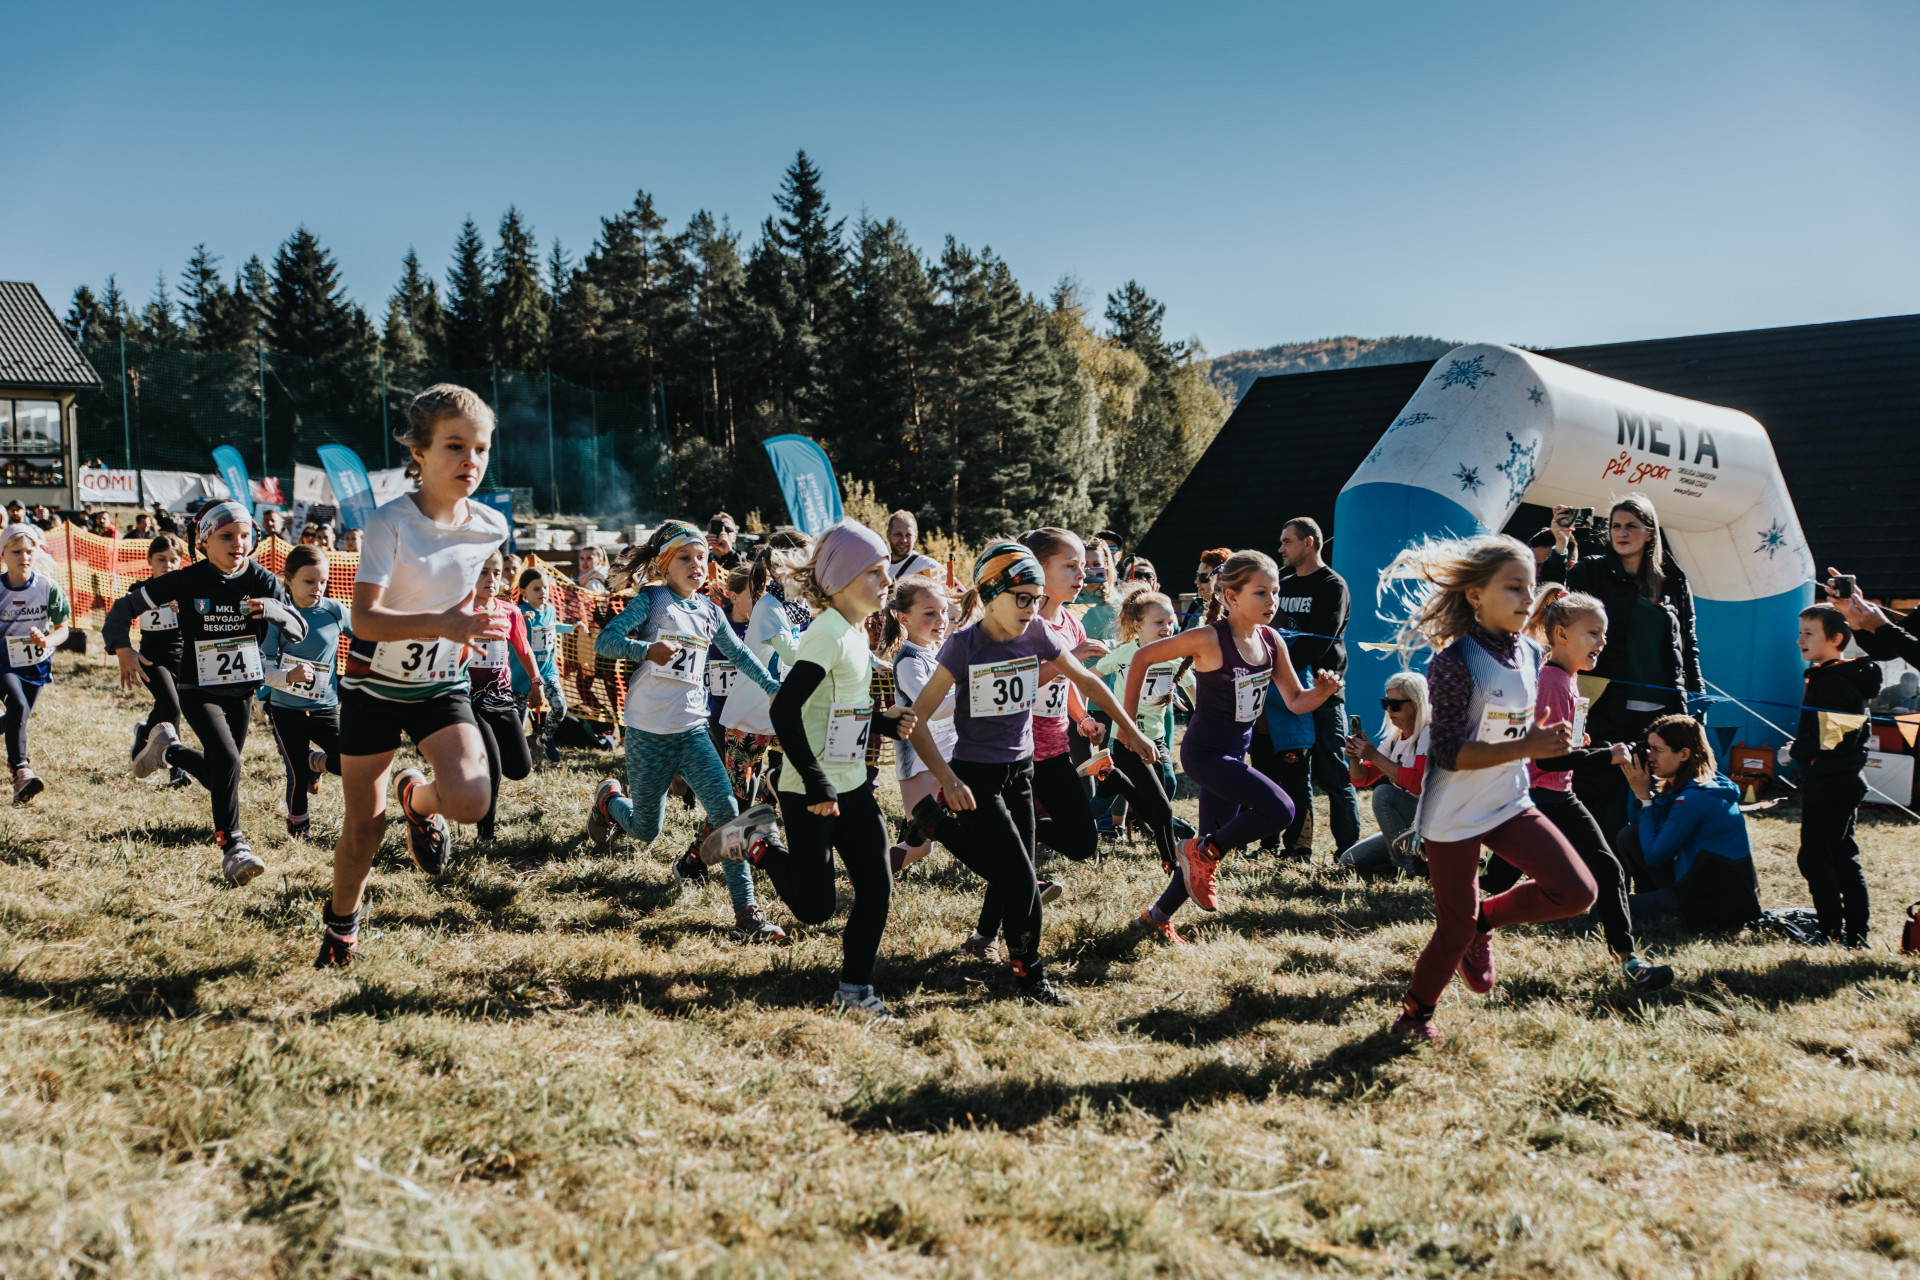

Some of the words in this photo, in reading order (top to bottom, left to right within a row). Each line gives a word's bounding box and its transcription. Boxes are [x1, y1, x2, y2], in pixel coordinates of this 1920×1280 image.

[1615, 408, 1719, 469] META
[83, 474, 132, 491] GOMI
[1627, 462, 1673, 485] SPORT
[151, 611, 161, 625] 2
[216, 605, 235, 613] MKL
[203, 623, 246, 632] BESKIDÓW
[23, 645, 44, 660] 18
[216, 651, 246, 676] 24
[401, 643, 440, 671] 31
[671, 648, 697, 673] 21
[993, 676, 1023, 705] 30
[1046, 684, 1066, 708] 33
[1146, 678, 1157, 696] 7
[1252, 685, 1268, 711] 27
